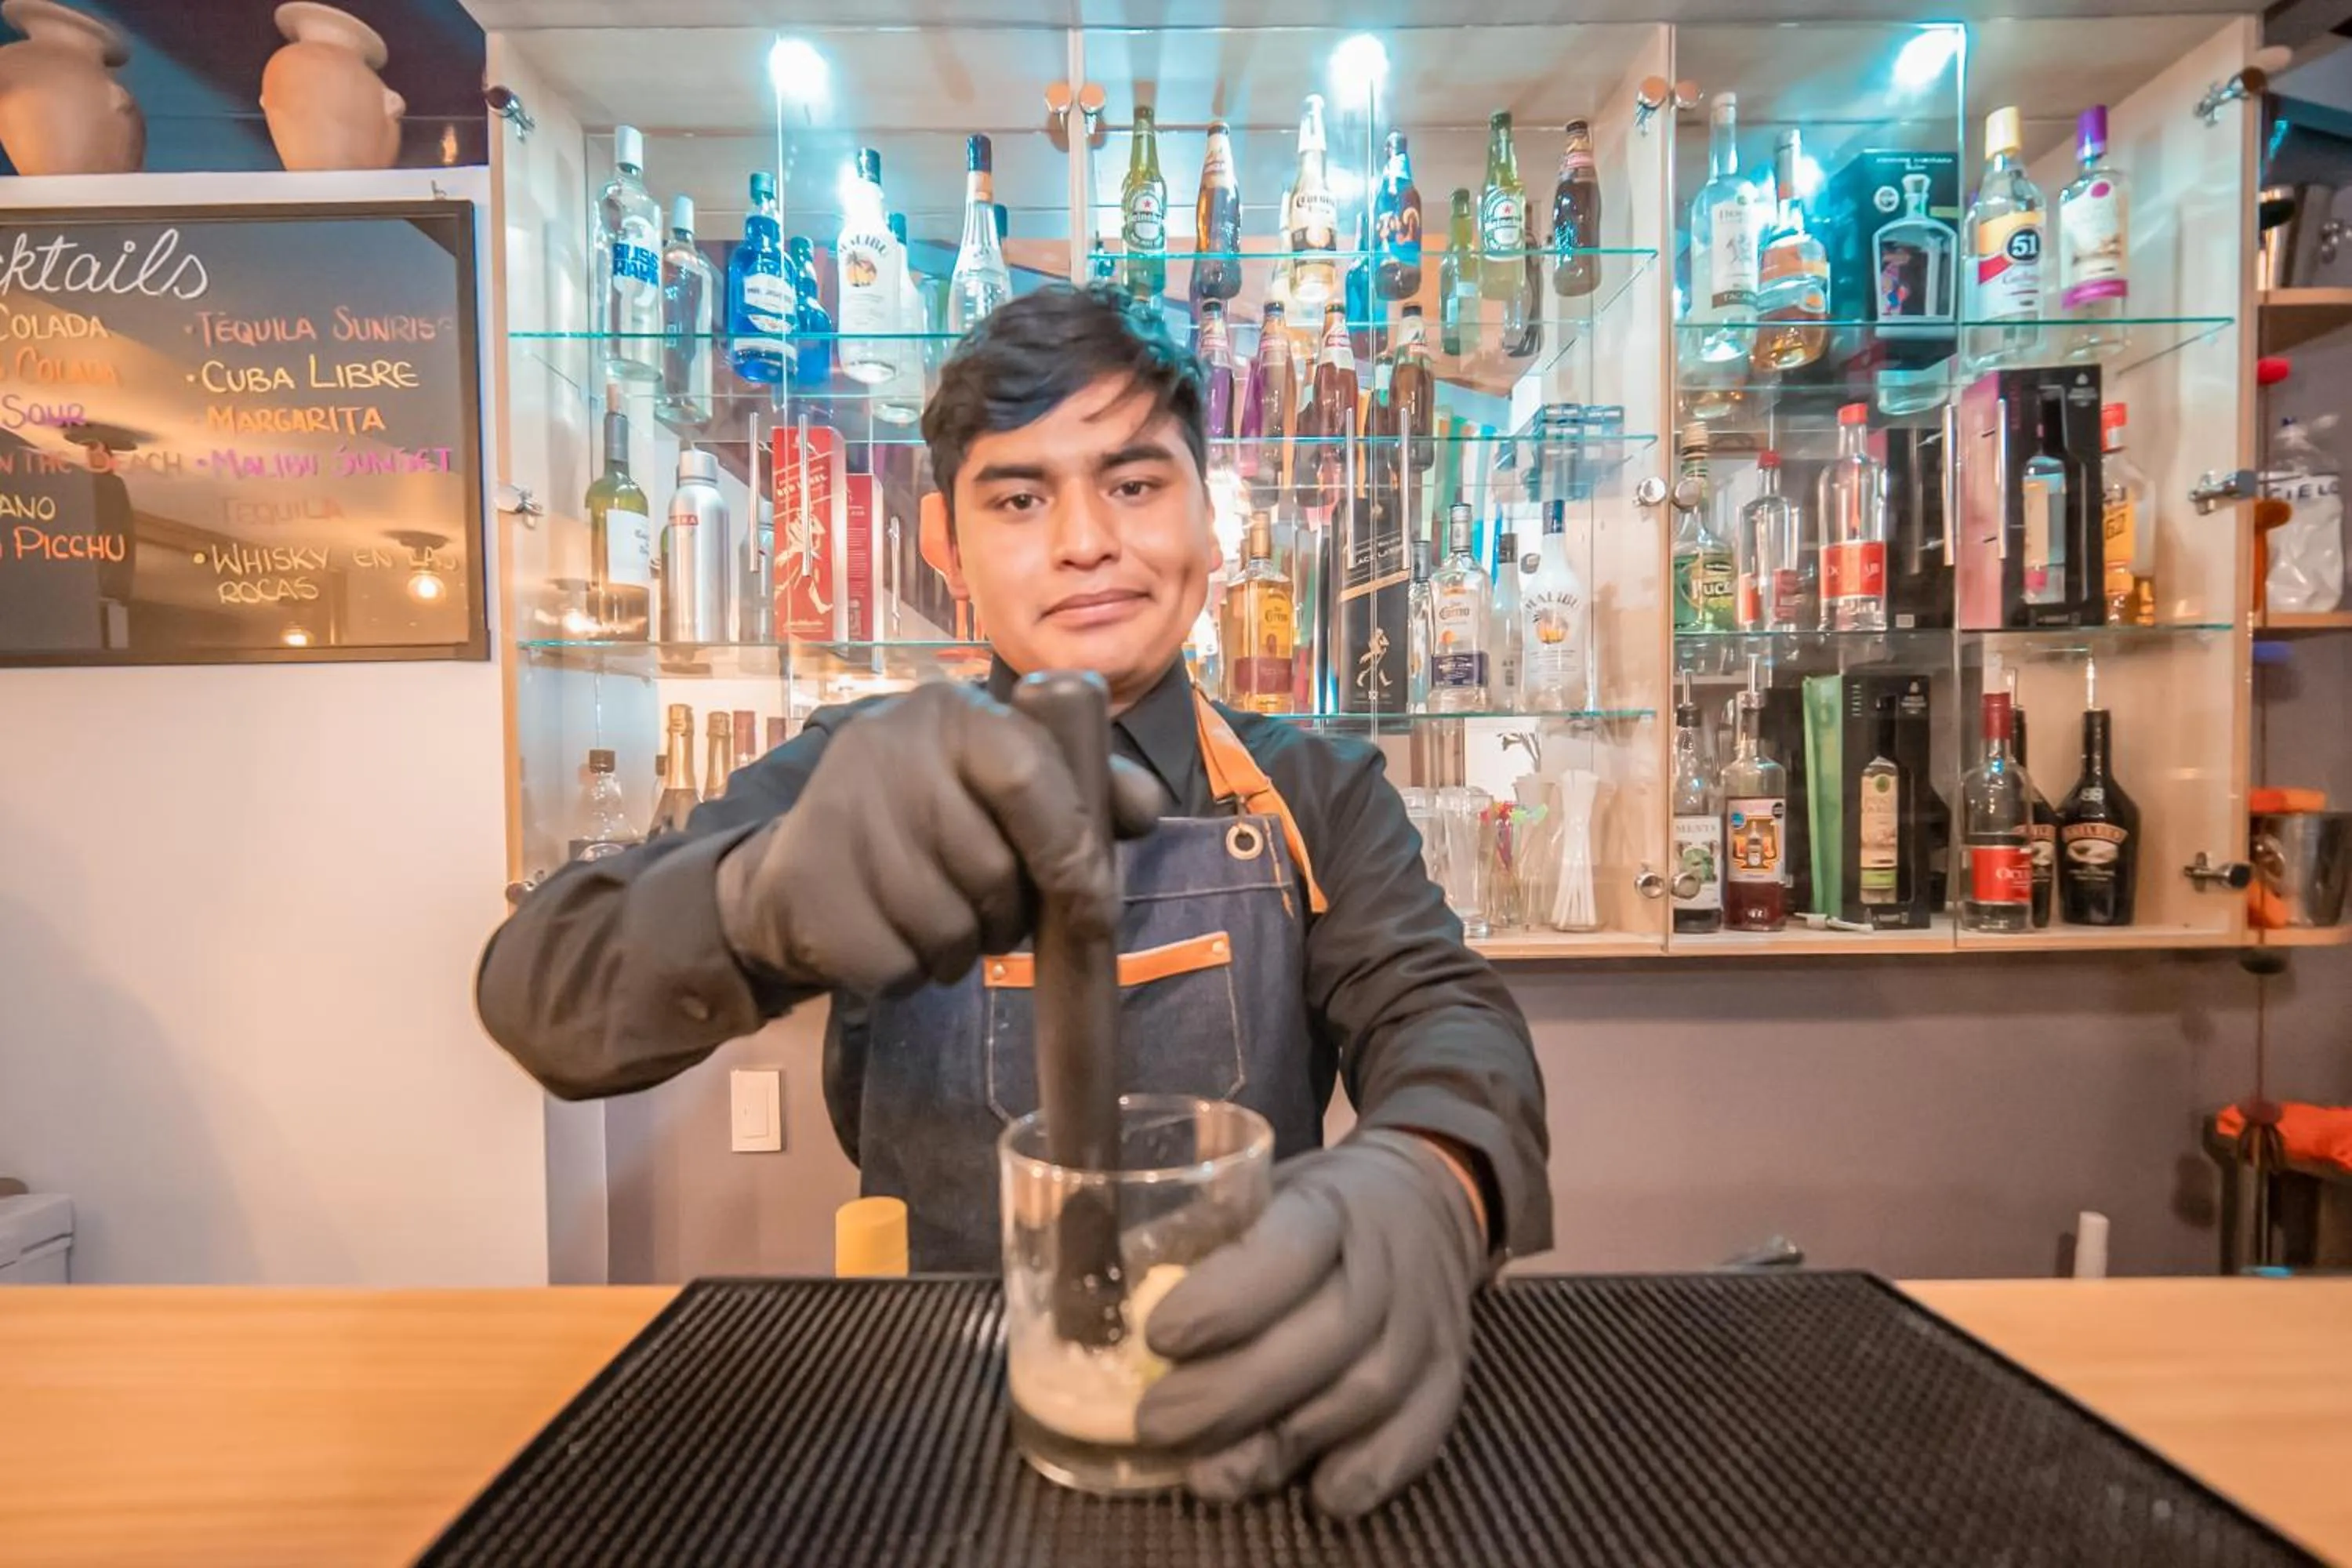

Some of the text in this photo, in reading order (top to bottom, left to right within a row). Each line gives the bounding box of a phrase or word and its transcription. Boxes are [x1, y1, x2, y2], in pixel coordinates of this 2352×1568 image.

[0, 228, 208, 299] ktails
[2011, 235, 2038, 257] 51
[196, 310, 317, 347] TEQUILA
[201, 354, 421, 393] CUBA LIBRE
[2, 394, 86, 429] SOUR
[206, 403, 387, 436] MARGARITA
[13, 526, 125, 562] PICCHU
[212, 543, 330, 576] WHISKY
[217, 577, 320, 604] ROCAS
